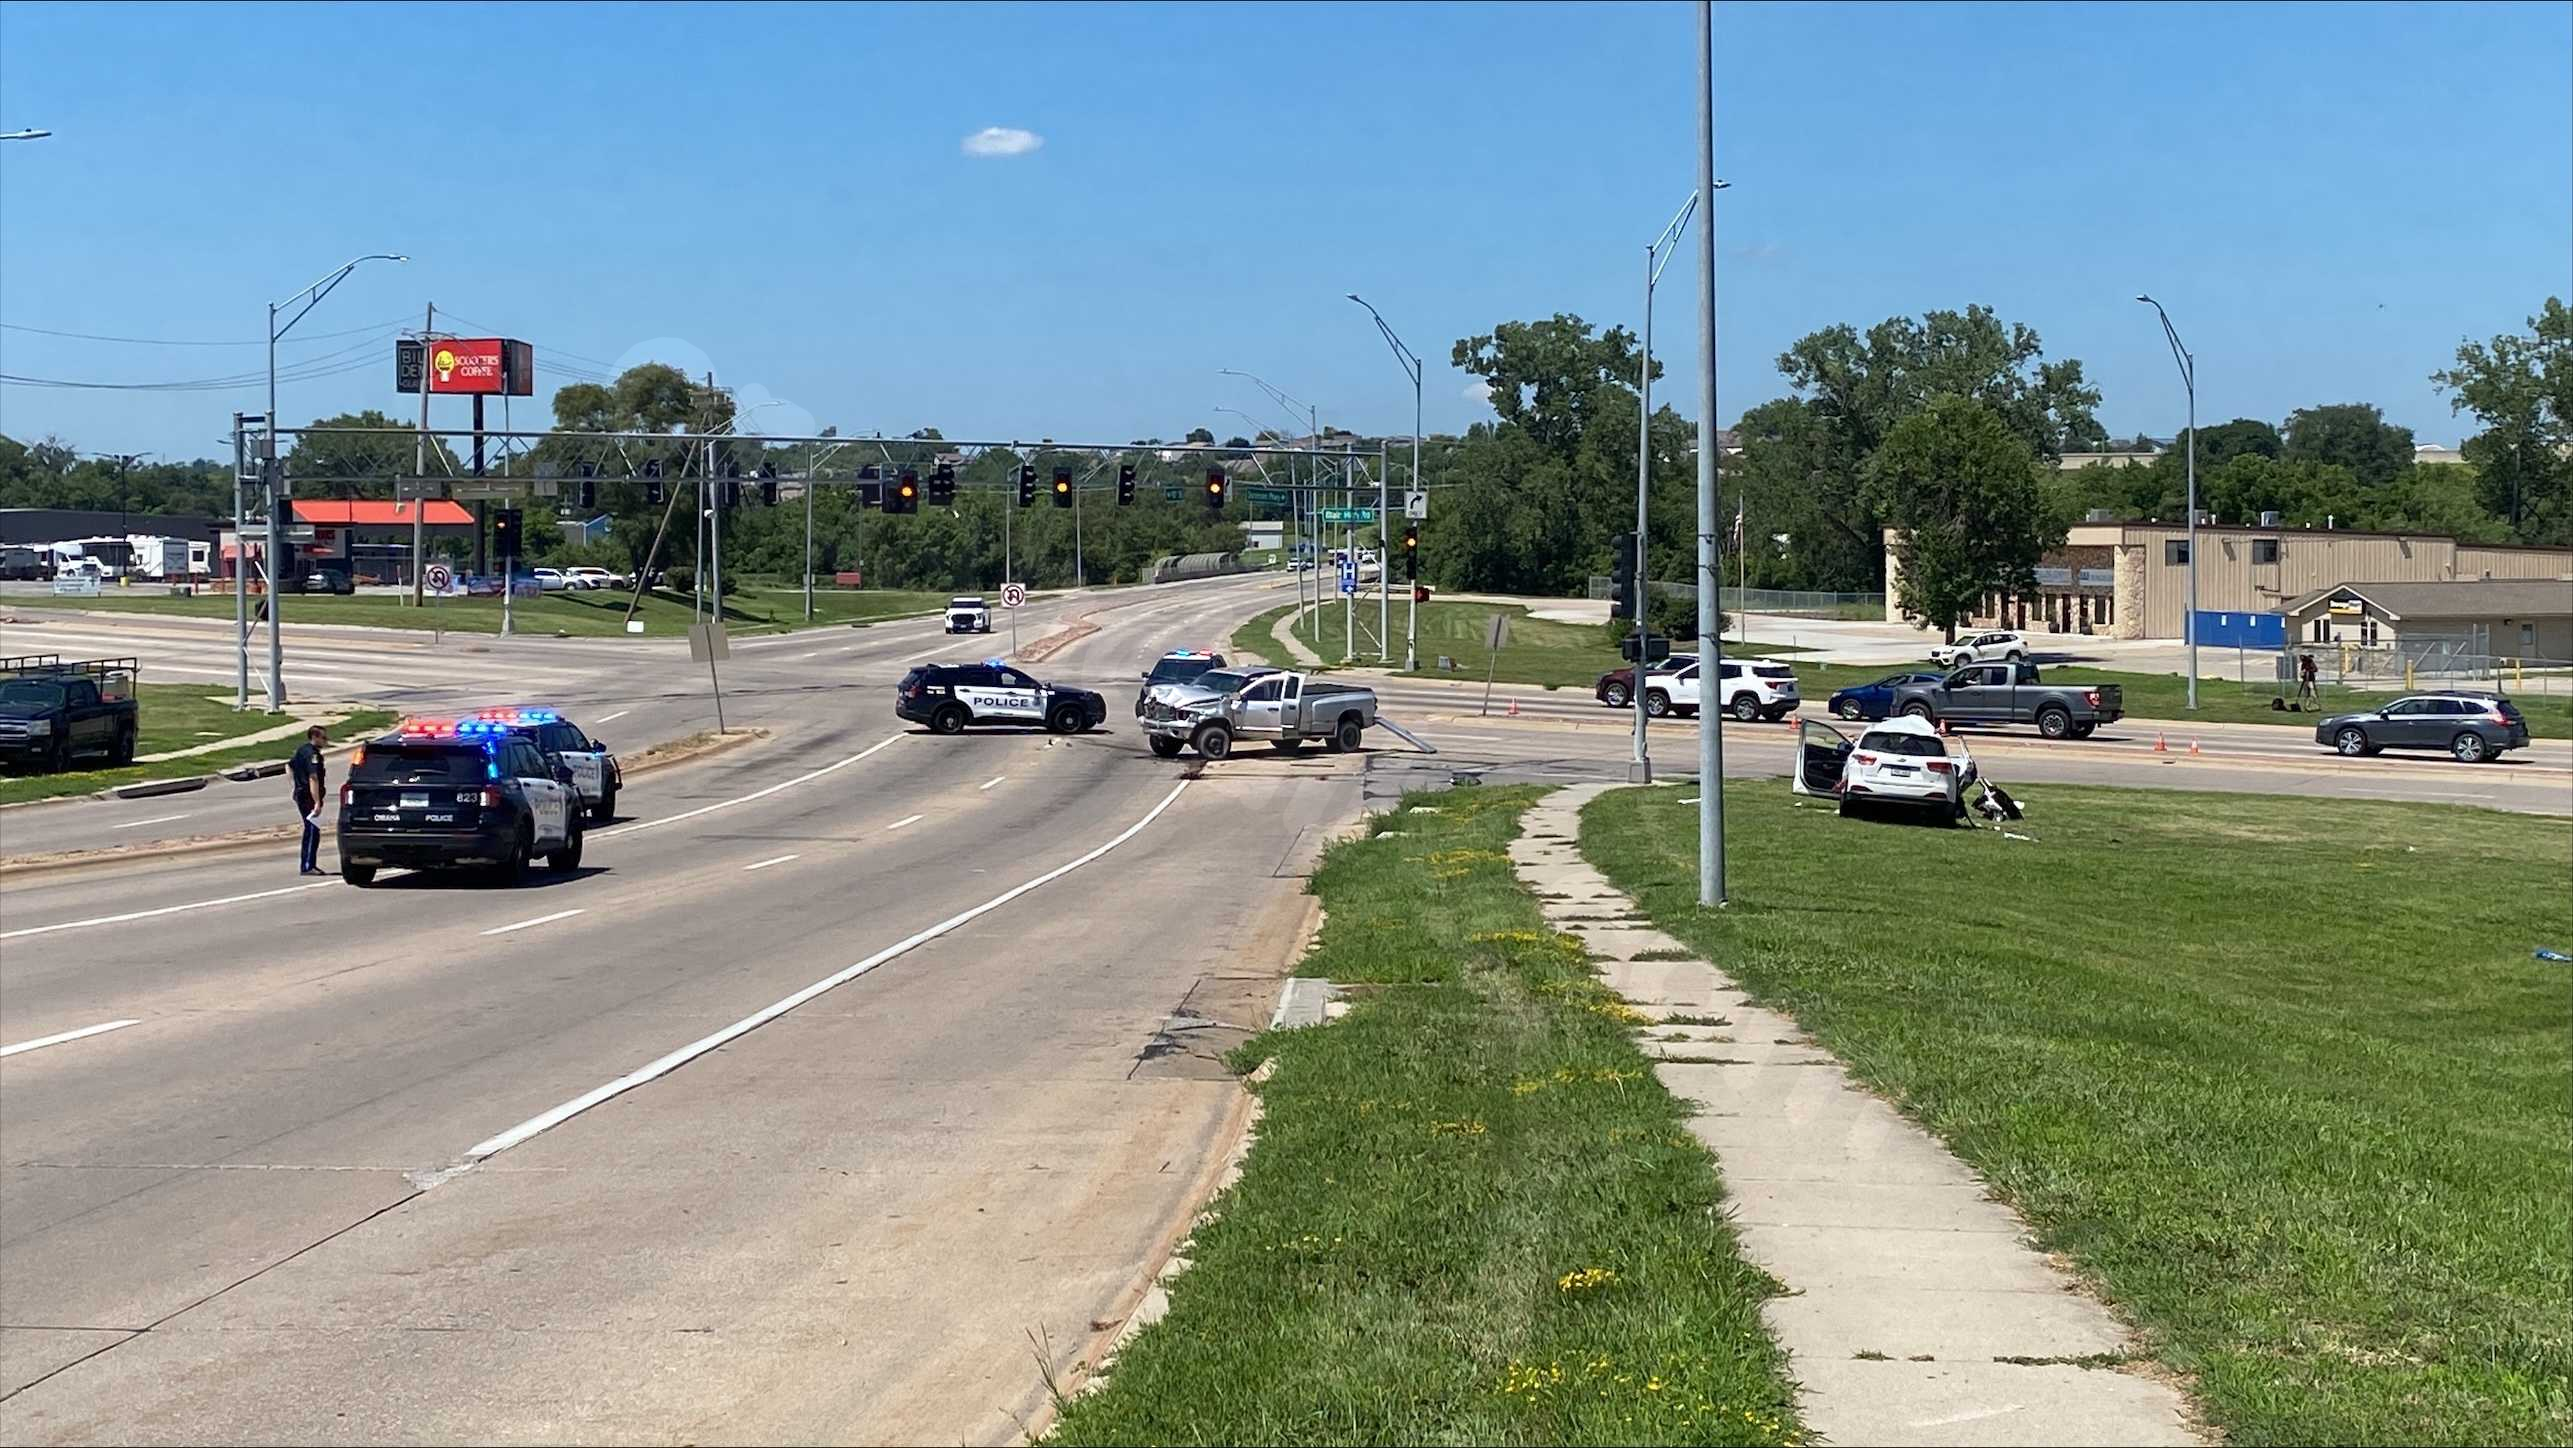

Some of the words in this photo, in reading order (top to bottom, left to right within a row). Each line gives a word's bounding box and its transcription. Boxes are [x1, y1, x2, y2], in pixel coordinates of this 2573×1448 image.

[1343, 563, 1355, 580] H
[973, 696, 1029, 708] POLICE
[456, 792, 478, 802] 823
[374, 814, 401, 822] OMAHA
[425, 814, 453, 822] POLICE
